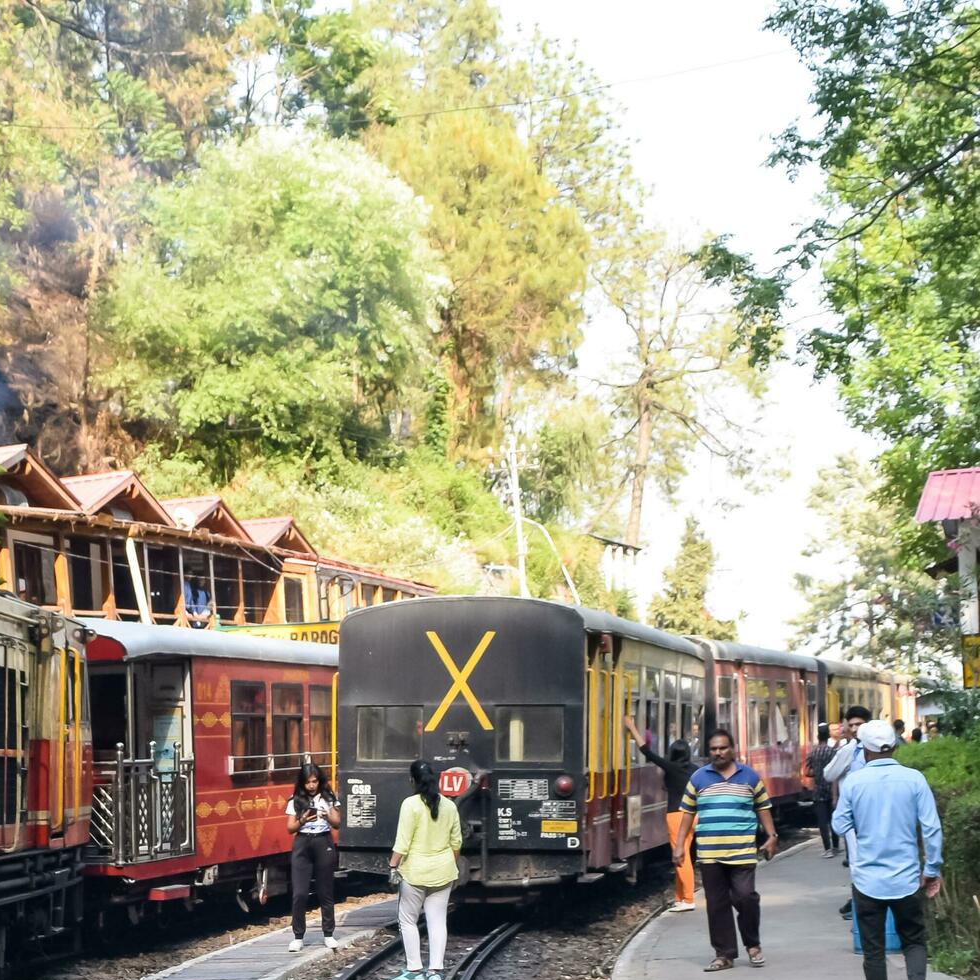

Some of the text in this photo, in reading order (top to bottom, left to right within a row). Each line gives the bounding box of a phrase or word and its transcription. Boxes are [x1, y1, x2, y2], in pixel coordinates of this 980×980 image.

[351, 784, 372, 795] GSR
[443, 775, 464, 792] LV
[567, 836, 580, 849] D
